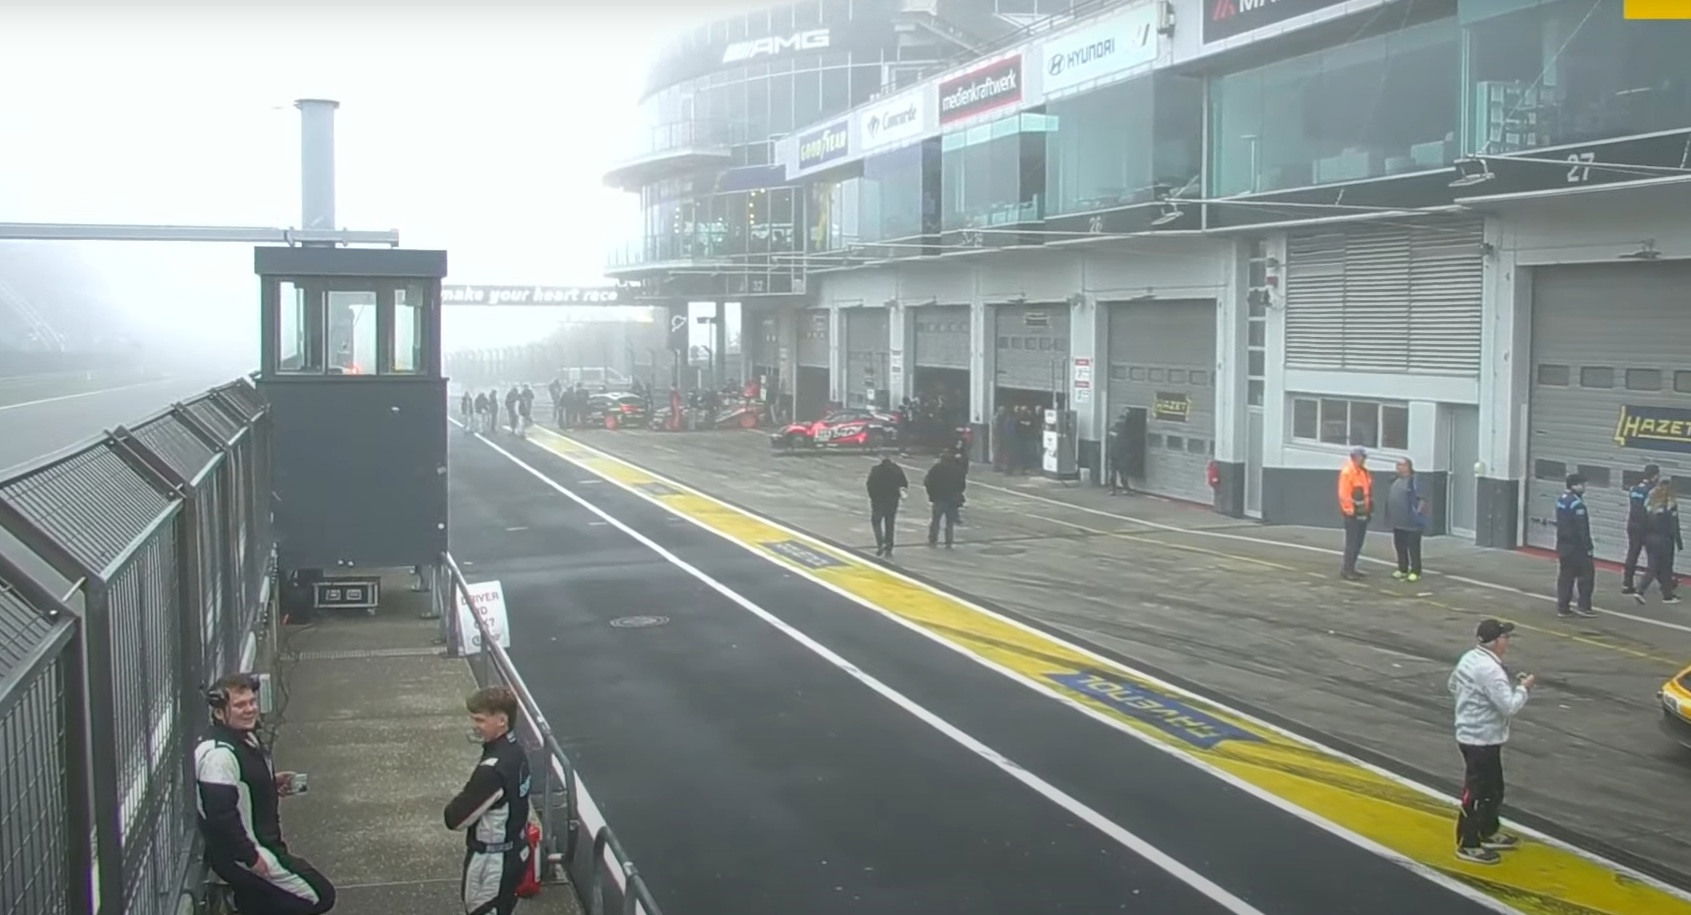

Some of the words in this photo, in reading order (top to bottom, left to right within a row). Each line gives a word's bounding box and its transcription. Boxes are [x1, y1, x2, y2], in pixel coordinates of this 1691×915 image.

[749, 28, 831, 58] AMG
[1067, 37, 1116, 69] HYUNDAI
[942, 68, 1017, 111] medienkraftwerk
[1567, 152, 1595, 182] 27
[441, 286, 483, 302] make
[488, 288, 530, 304] your
[533, 286, 579, 303] heart
[582, 290, 618, 302] race
